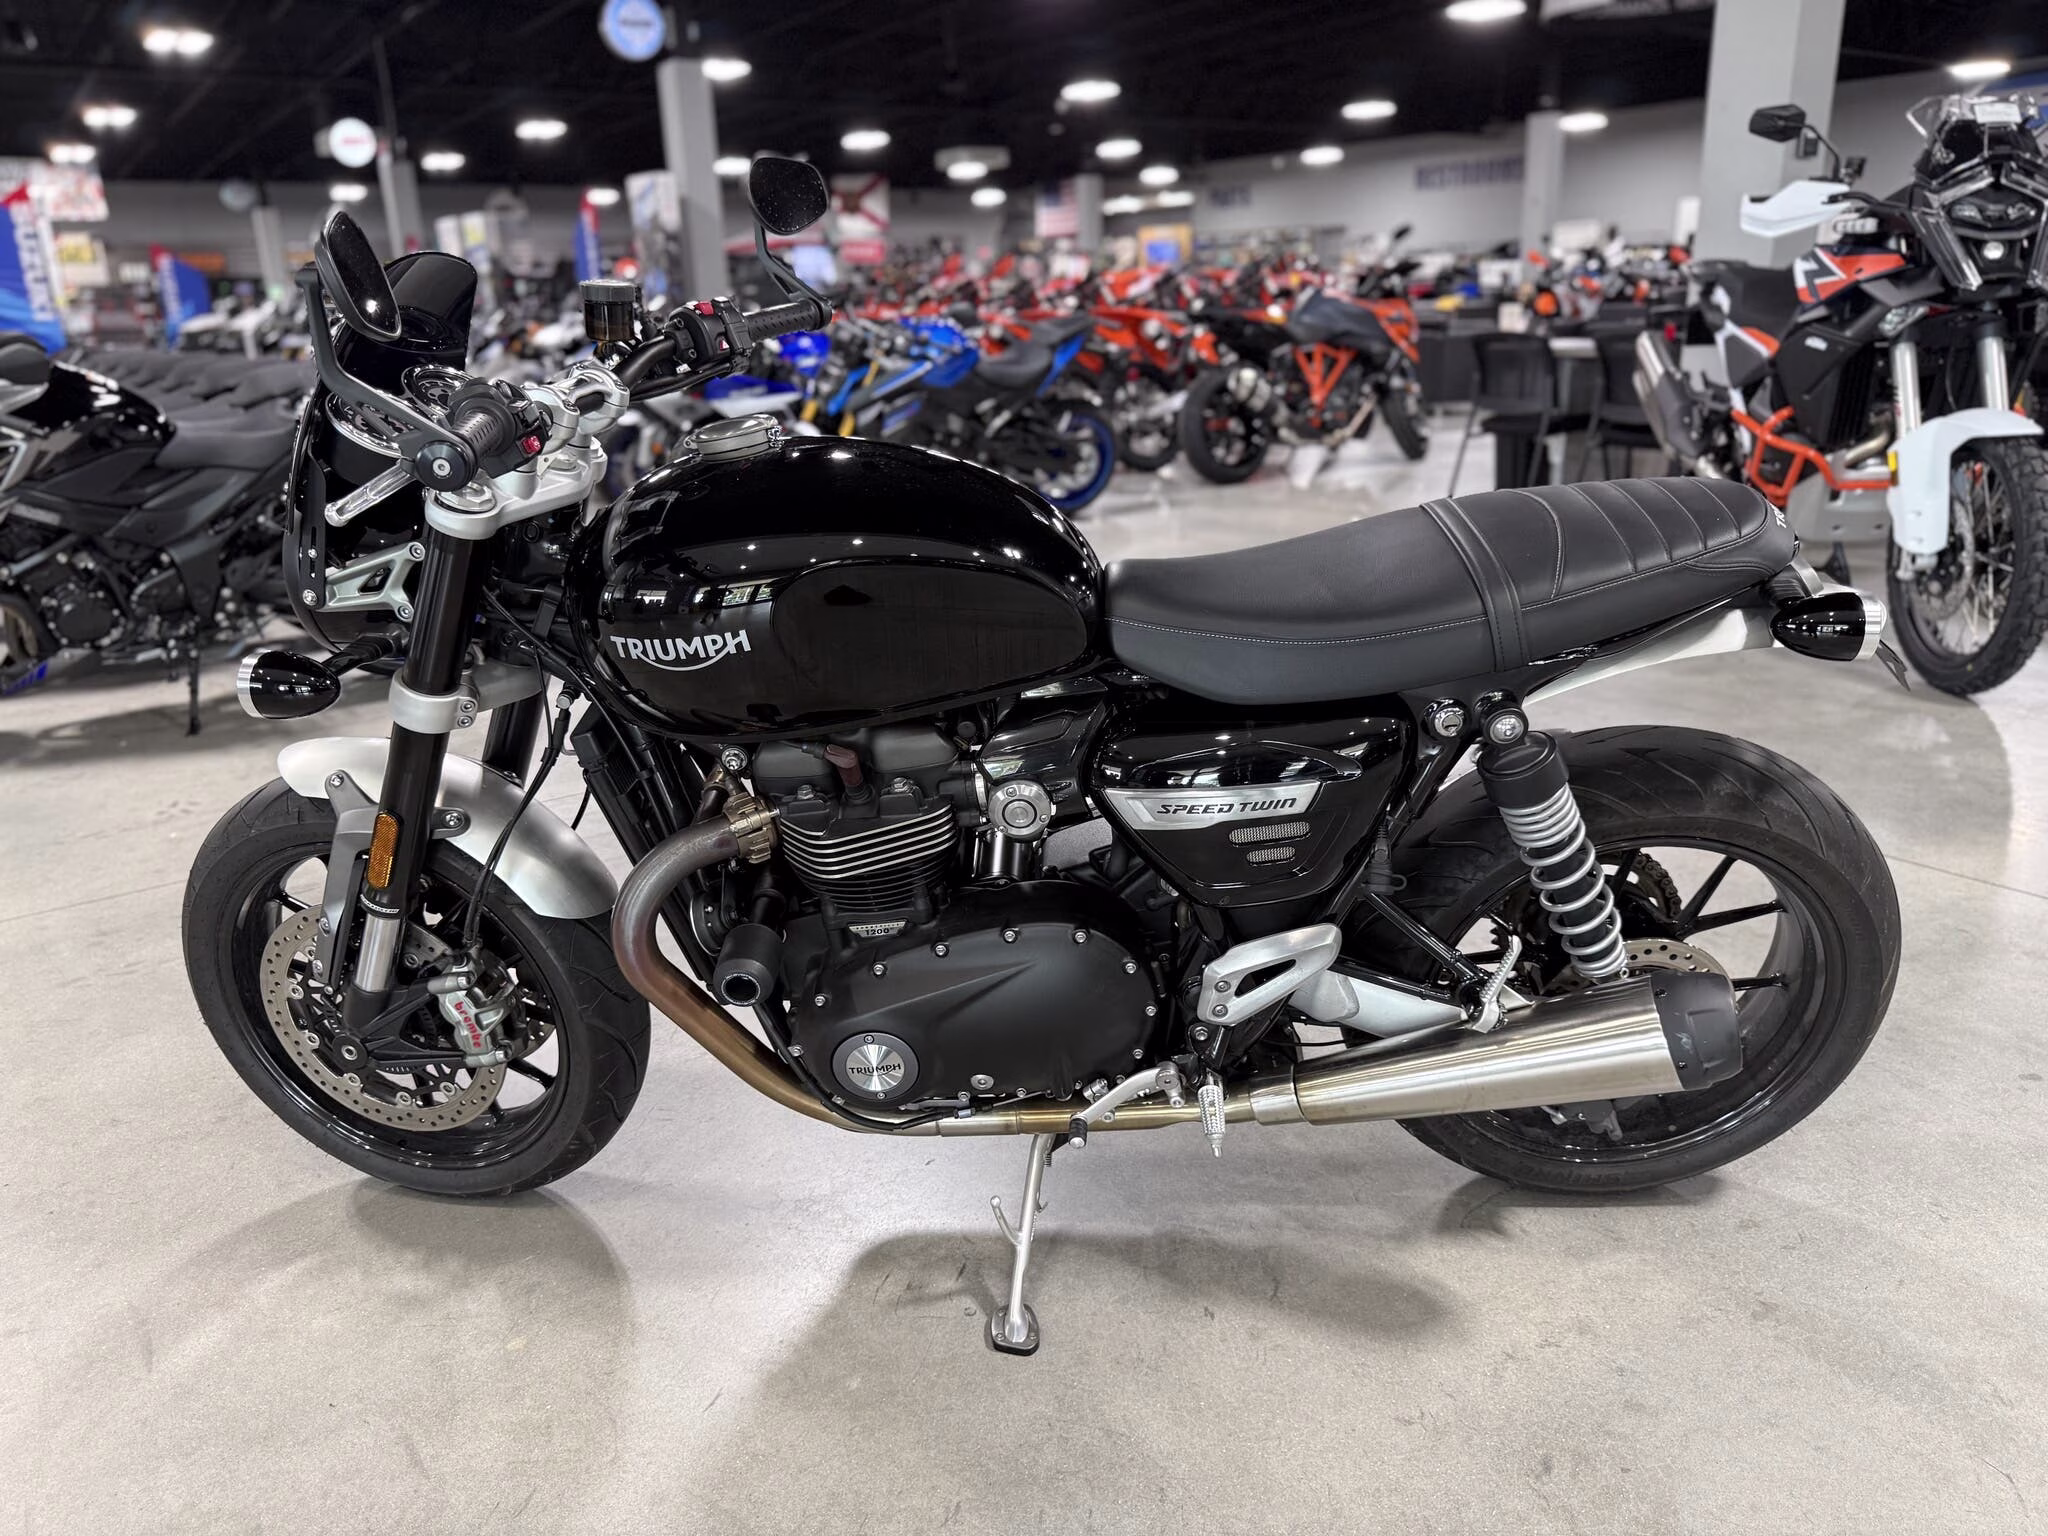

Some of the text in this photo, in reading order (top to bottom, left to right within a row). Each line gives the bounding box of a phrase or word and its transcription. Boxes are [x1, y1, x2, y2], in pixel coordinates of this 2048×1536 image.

[610, 629, 751, 671] TRIUMPH
[1157, 797, 1297, 815] SPEED TWIN
[865, 927, 890, 936] 1200
[454, 1001, 482, 1049] brembo
[848, 1063, 902, 1077] TRIUMPH
